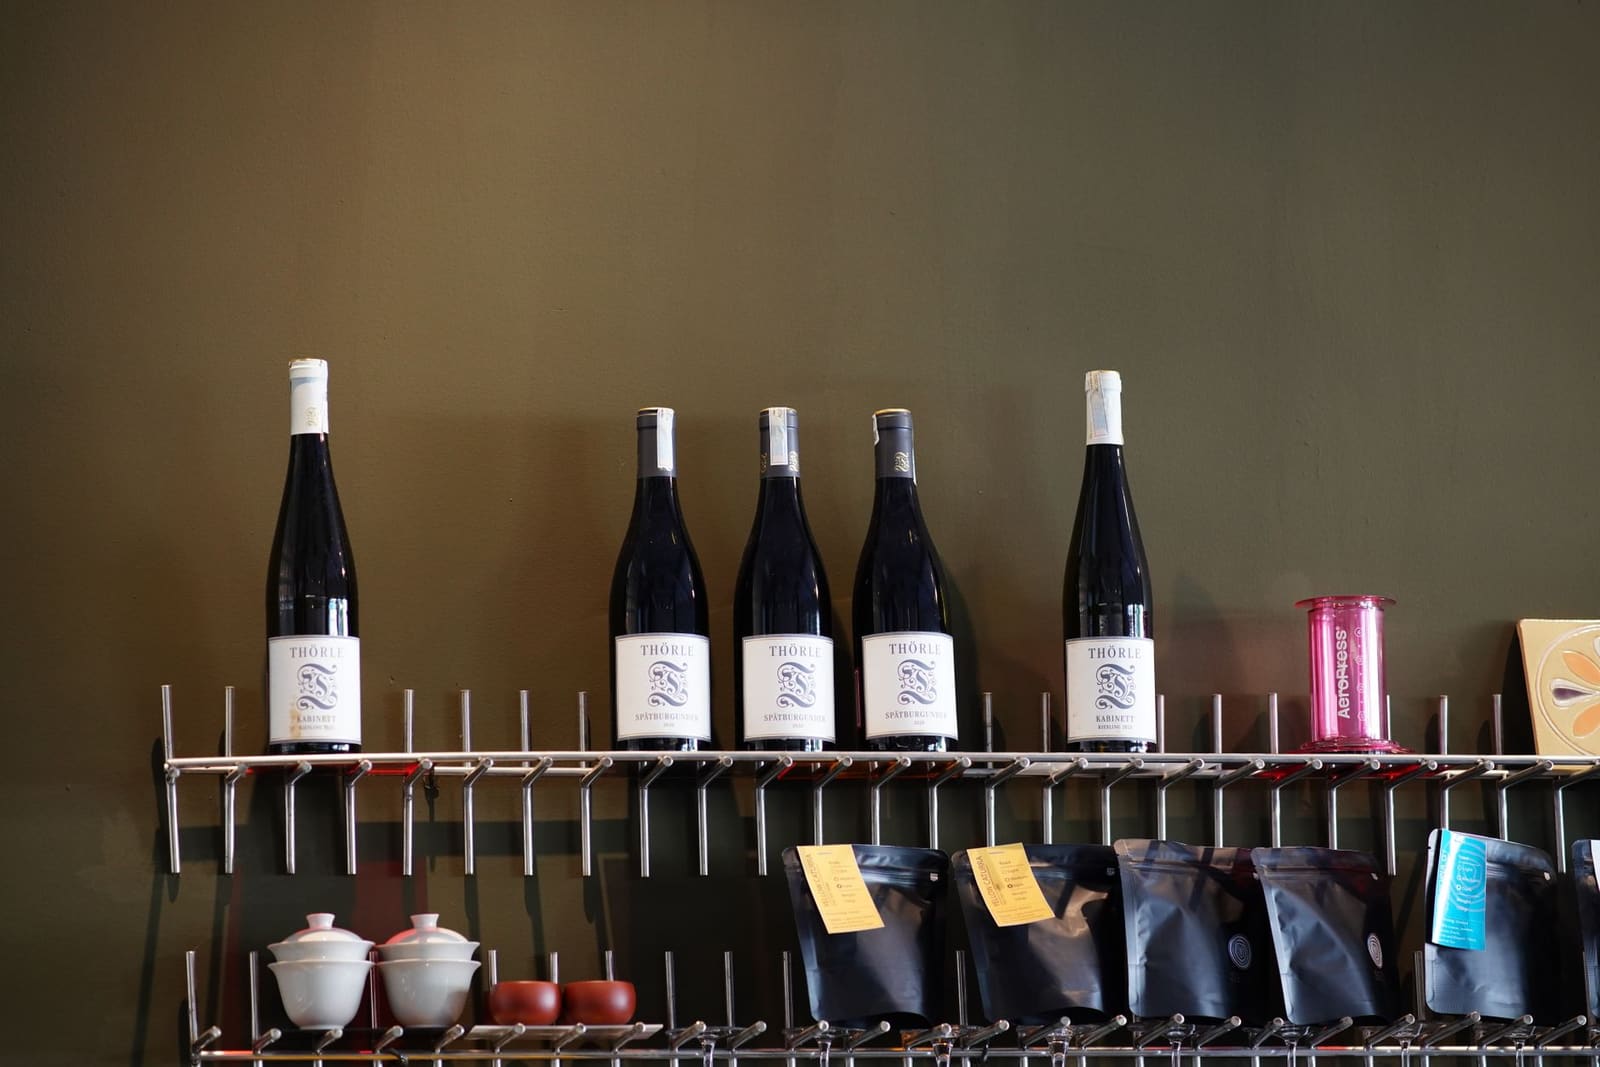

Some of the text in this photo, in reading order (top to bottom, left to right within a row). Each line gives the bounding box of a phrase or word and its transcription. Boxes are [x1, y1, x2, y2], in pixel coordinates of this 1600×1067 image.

[289, 644, 345, 658] THÖRLE
[640, 642, 694, 656] THÖRLE
[769, 643, 823, 657] THÖRLE
[888, 641, 941, 655] THÖRLE
[1088, 644, 1142, 659] THÖRLE
[1096, 715, 1134, 723] KABINETT
